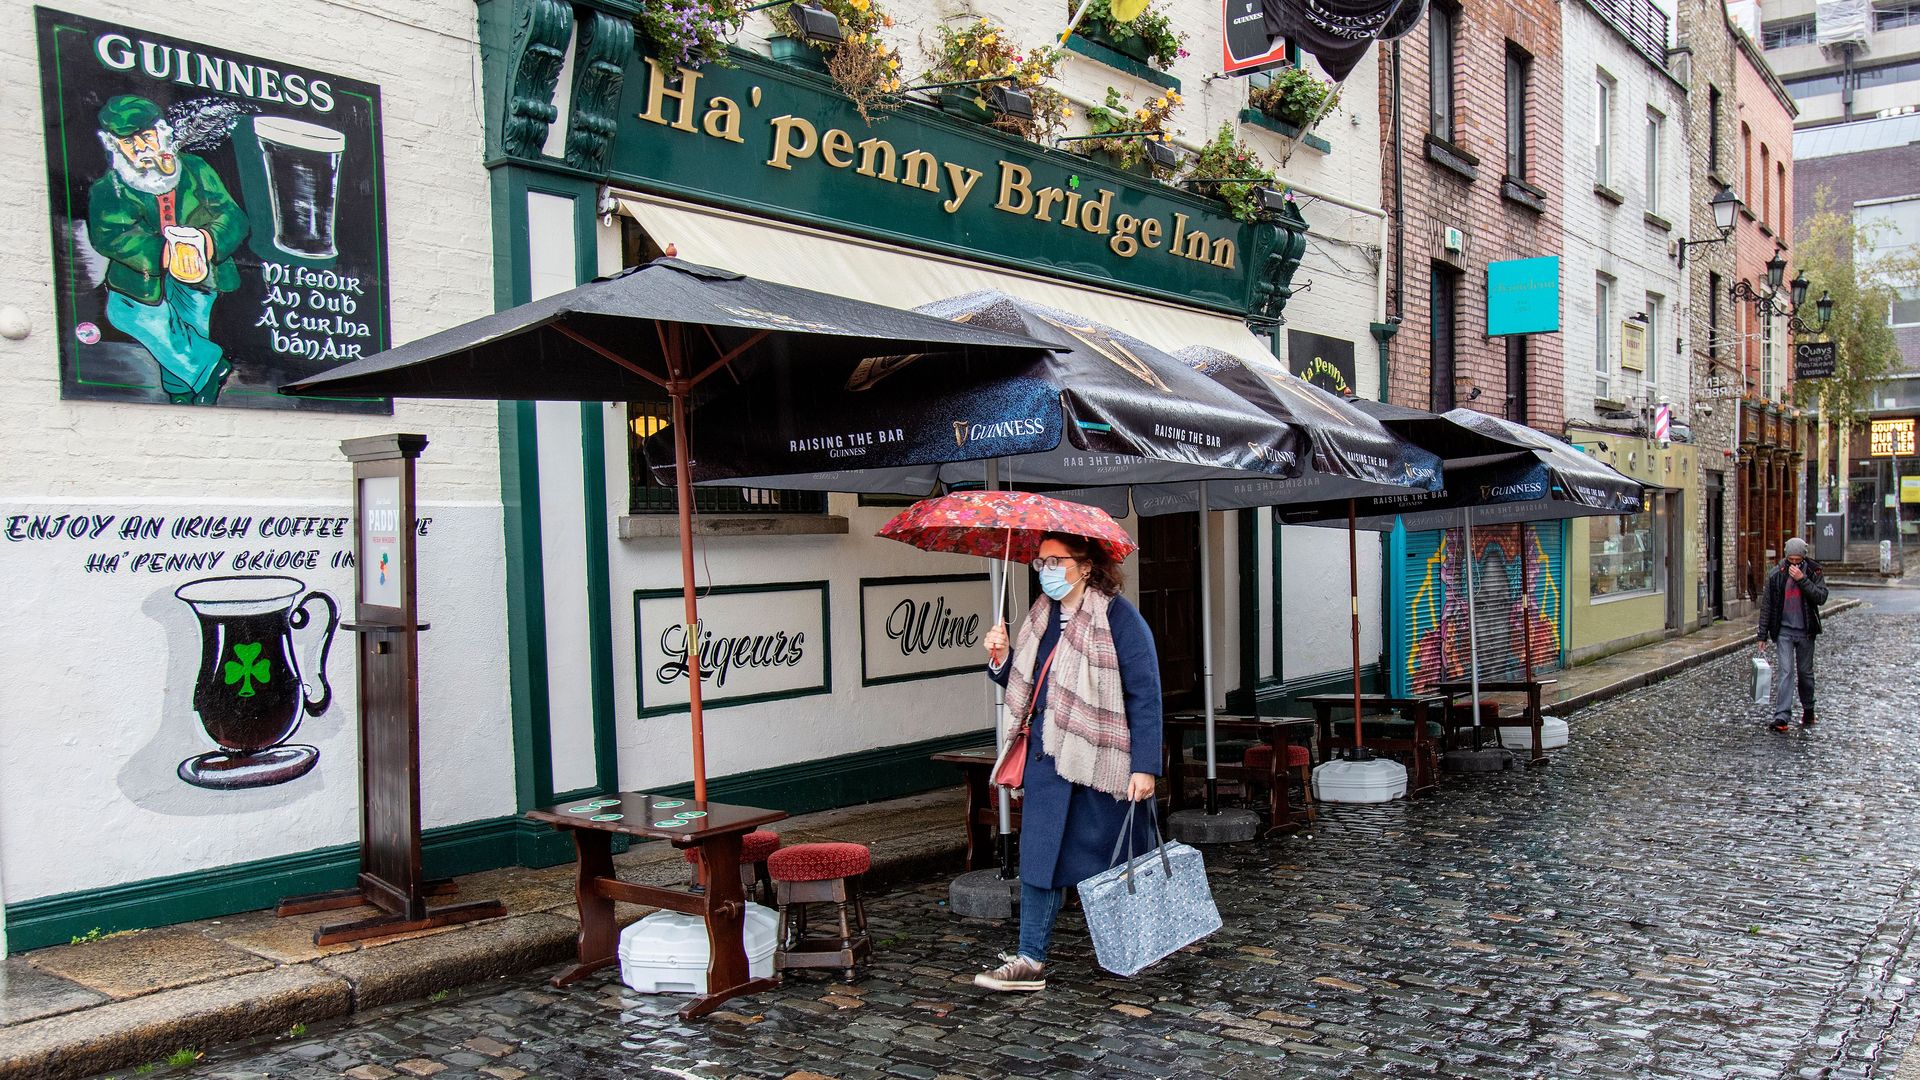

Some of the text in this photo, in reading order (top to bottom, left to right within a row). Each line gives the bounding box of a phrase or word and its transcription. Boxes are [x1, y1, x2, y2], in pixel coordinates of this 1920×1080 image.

[96, 34, 335, 112] GUINNESS
[639, 56, 1236, 270] Ha'penny Bridge Inn
[262, 285, 301, 308] An
[255, 306, 279, 327] A
[1799, 345, 1832, 357] Quays
[790, 429, 905, 452] RAISING THE BAR
[970, 418, 1045, 441] GUINNESS
[1154, 423, 1221, 448] RAISING THE BAR
[829, 447, 866, 458] GUINNESS
[1347, 451, 1366, 463] RAISING
[1368, 455, 1378, 466] THE
[1378, 457, 1389, 468] BAR
[1373, 490, 1448, 505] RAISING THE BAR
[1490, 482, 1541, 497] GUINNESS
[5, 514, 349, 541] ENJOY AN IRISH COFFEE
[368, 509, 399, 531] PADDY
[331, 550, 355, 570] IN
[885, 595, 979, 656] Wine
